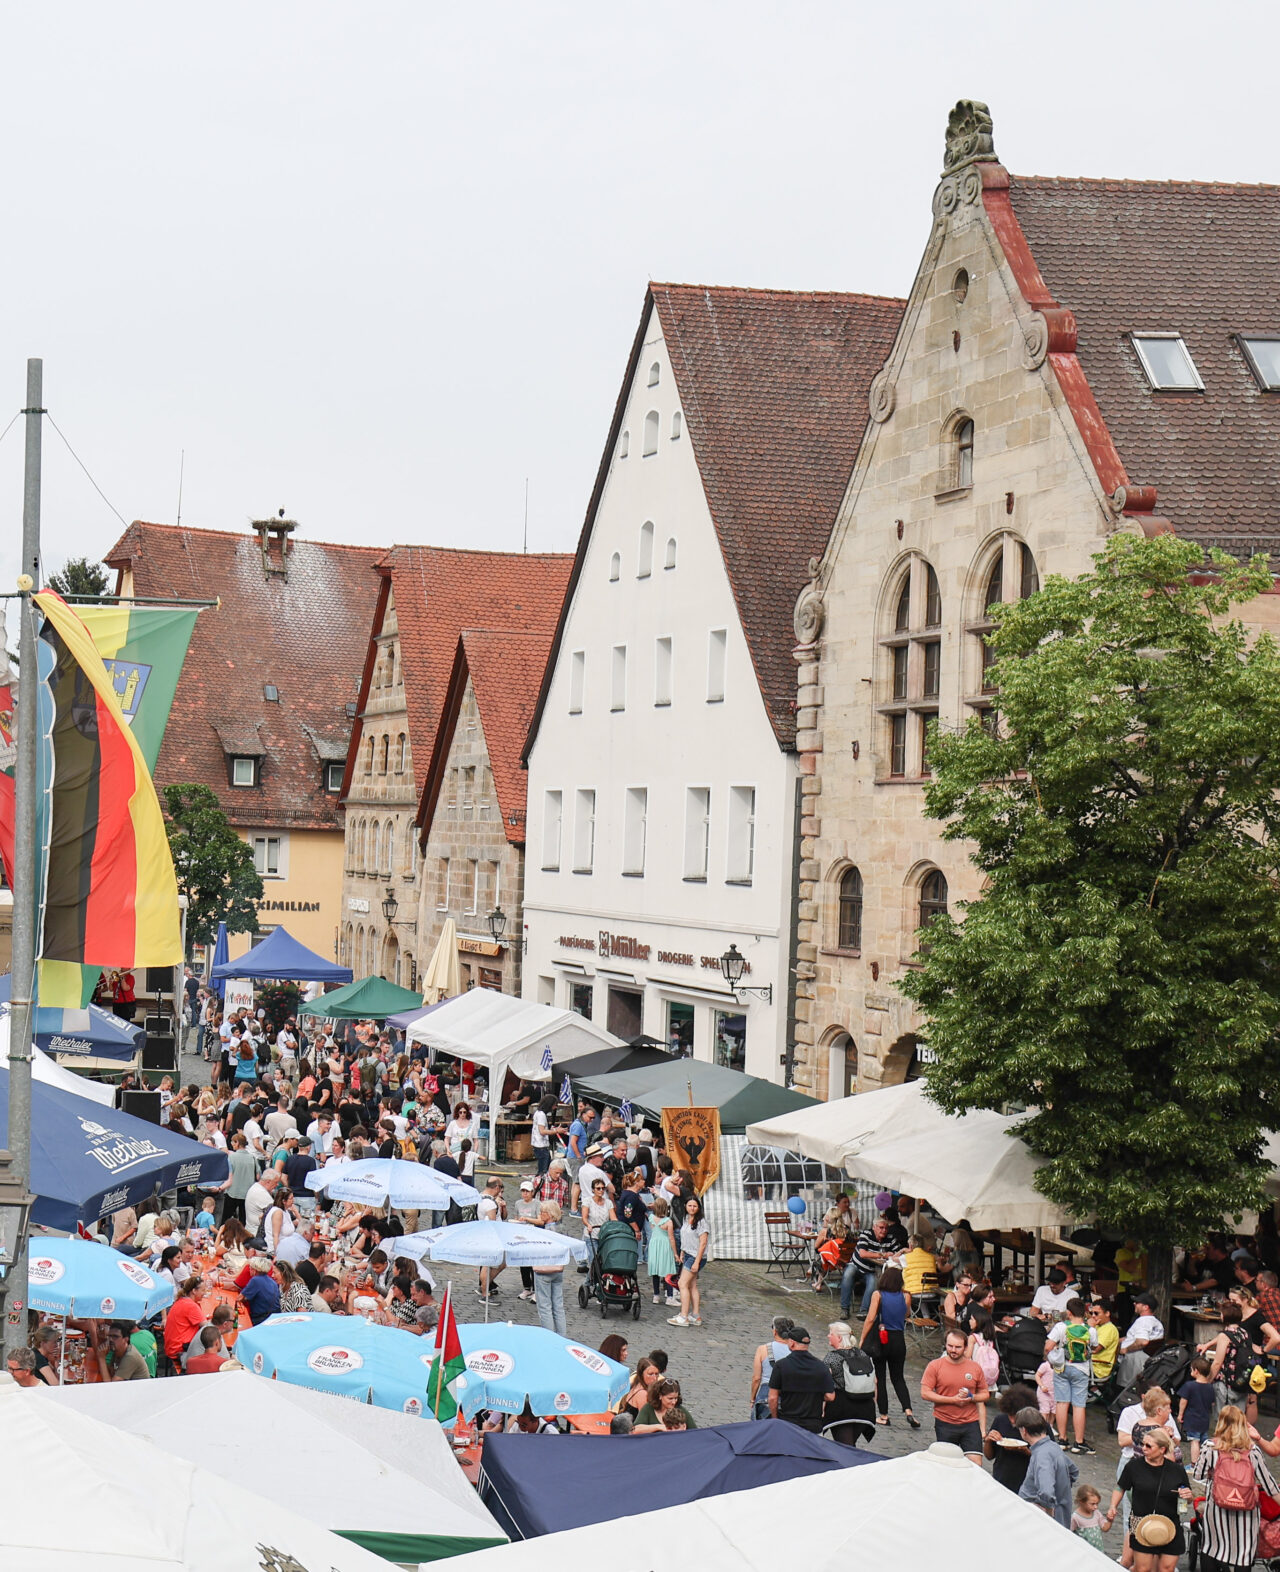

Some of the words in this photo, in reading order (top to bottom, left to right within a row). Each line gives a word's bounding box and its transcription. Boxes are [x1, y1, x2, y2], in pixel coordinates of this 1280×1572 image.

[257, 900, 321, 912] XIMILIAN
[610, 934, 651, 960] Müller
[657, 950, 694, 966] DROGERIE
[85, 1136, 169, 1175] Wiethaler
[29, 1266, 57, 1275] RANKEN
[31, 1299, 65, 1311] BRUNNEN
[316, 1355, 353, 1368] FRANKEN
[469, 1360, 505, 1370] FRANKEN
[468, 1364, 504, 1374] BRUNNEN
[485, 1396, 519, 1409] RUNNEN
